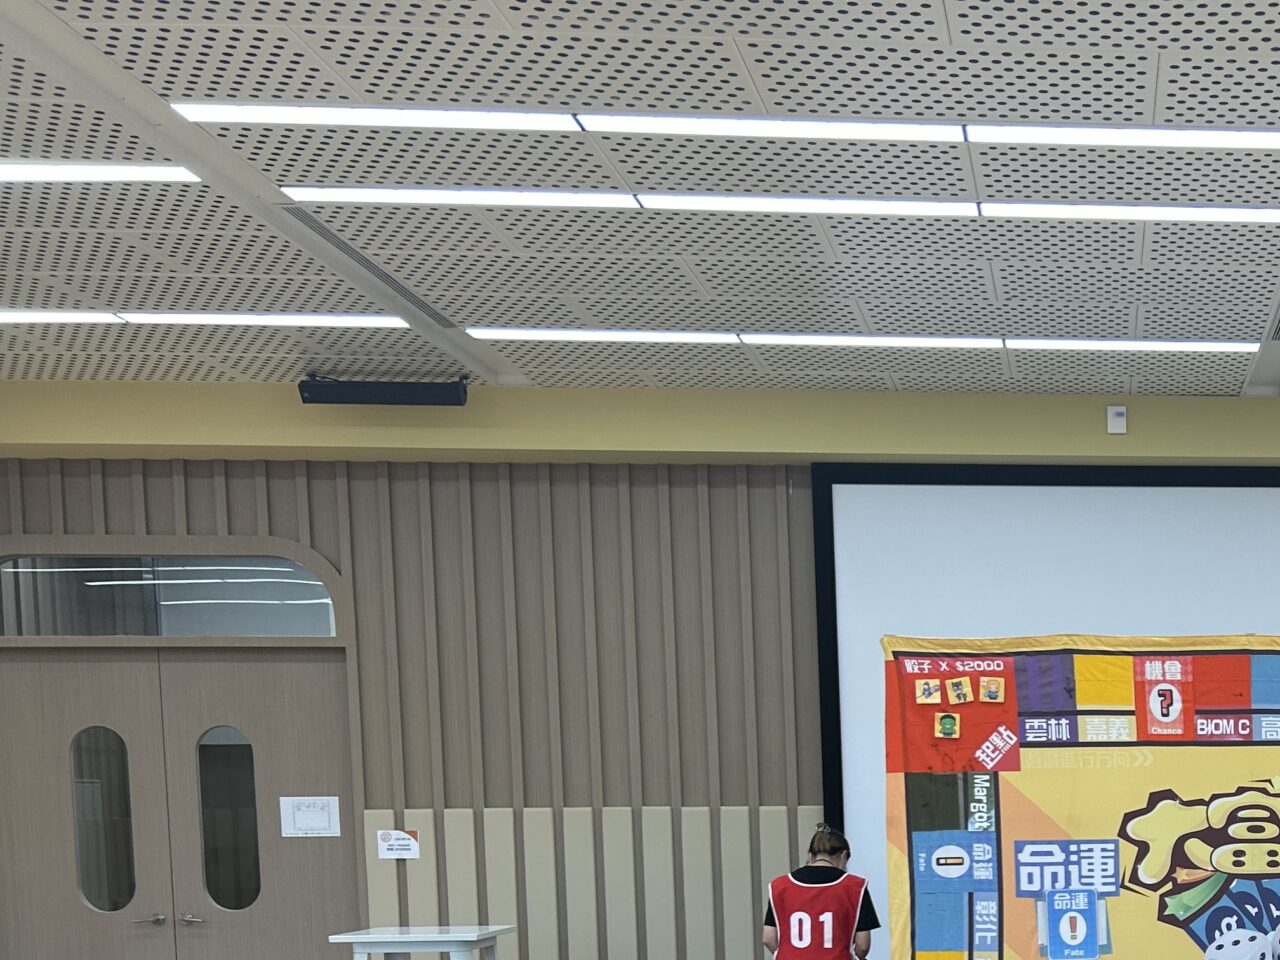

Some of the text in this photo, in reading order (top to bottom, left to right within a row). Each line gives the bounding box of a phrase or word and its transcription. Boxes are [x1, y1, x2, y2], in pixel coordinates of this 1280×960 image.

[904, 659, 932, 673] 骰子
[956, 660, 1004, 671] $2000
[1144, 660, 1182, 680] 機會
[1025, 718, 1070, 742] 雲林
[1085, 717, 1130, 741] 嘉義
[1151, 727, 1182, 735] Chance
[1239, 719, 1250, 735] C
[974, 725, 1018, 770] 起點
[970, 774, 990, 829] Margot
[972, 843, 993, 880] 命運
[1018, 843, 1116, 892] 命運
[1054, 892, 1088, 910] 命運
[790, 911, 833, 948] 01
[975, 901, 997, 945] 彰化
